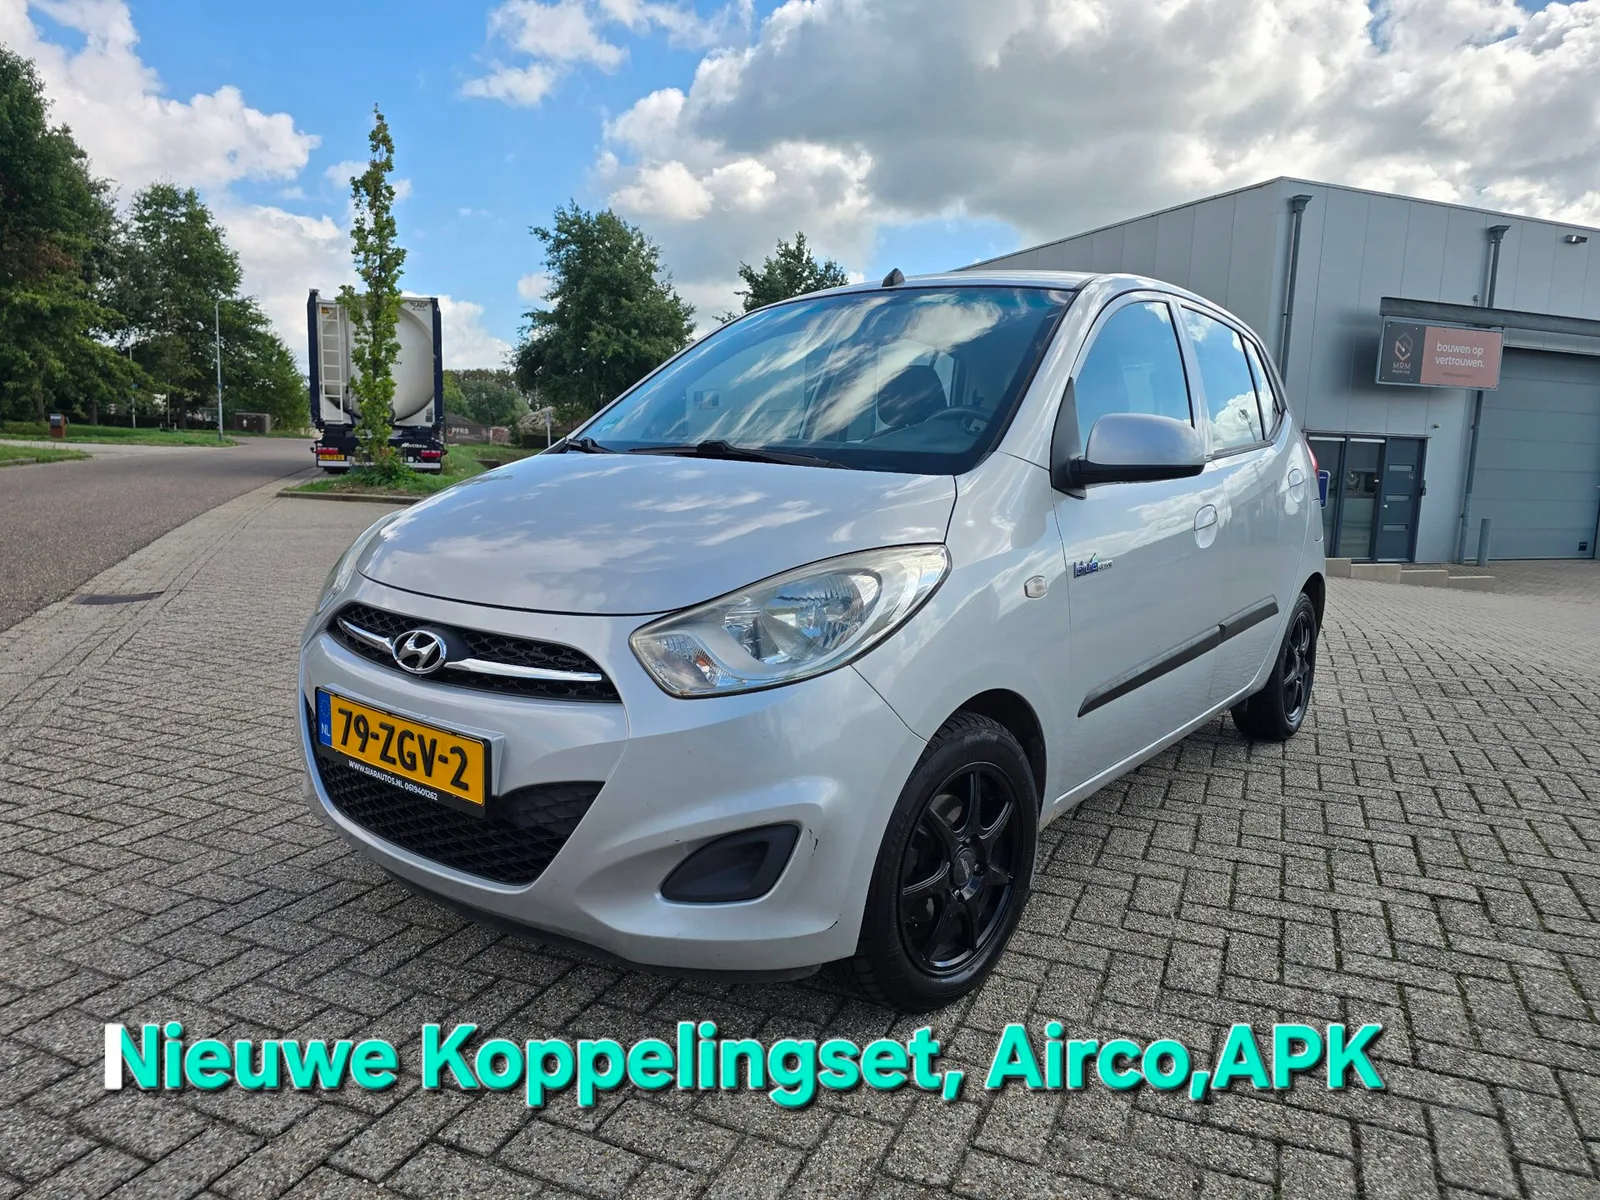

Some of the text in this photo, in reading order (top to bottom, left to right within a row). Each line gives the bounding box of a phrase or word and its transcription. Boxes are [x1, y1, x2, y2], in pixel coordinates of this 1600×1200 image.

[1436, 341, 1484, 357] bouwen op
[1392, 361, 1411, 371] MRM
[1435, 355, 1485, 368] vertrouwen.
[321, 723, 331, 737] NL
[337, 707, 469, 791] 79-ZGV-2
[348, 759, 404, 789] WWW.SIARAUTOS.NL
